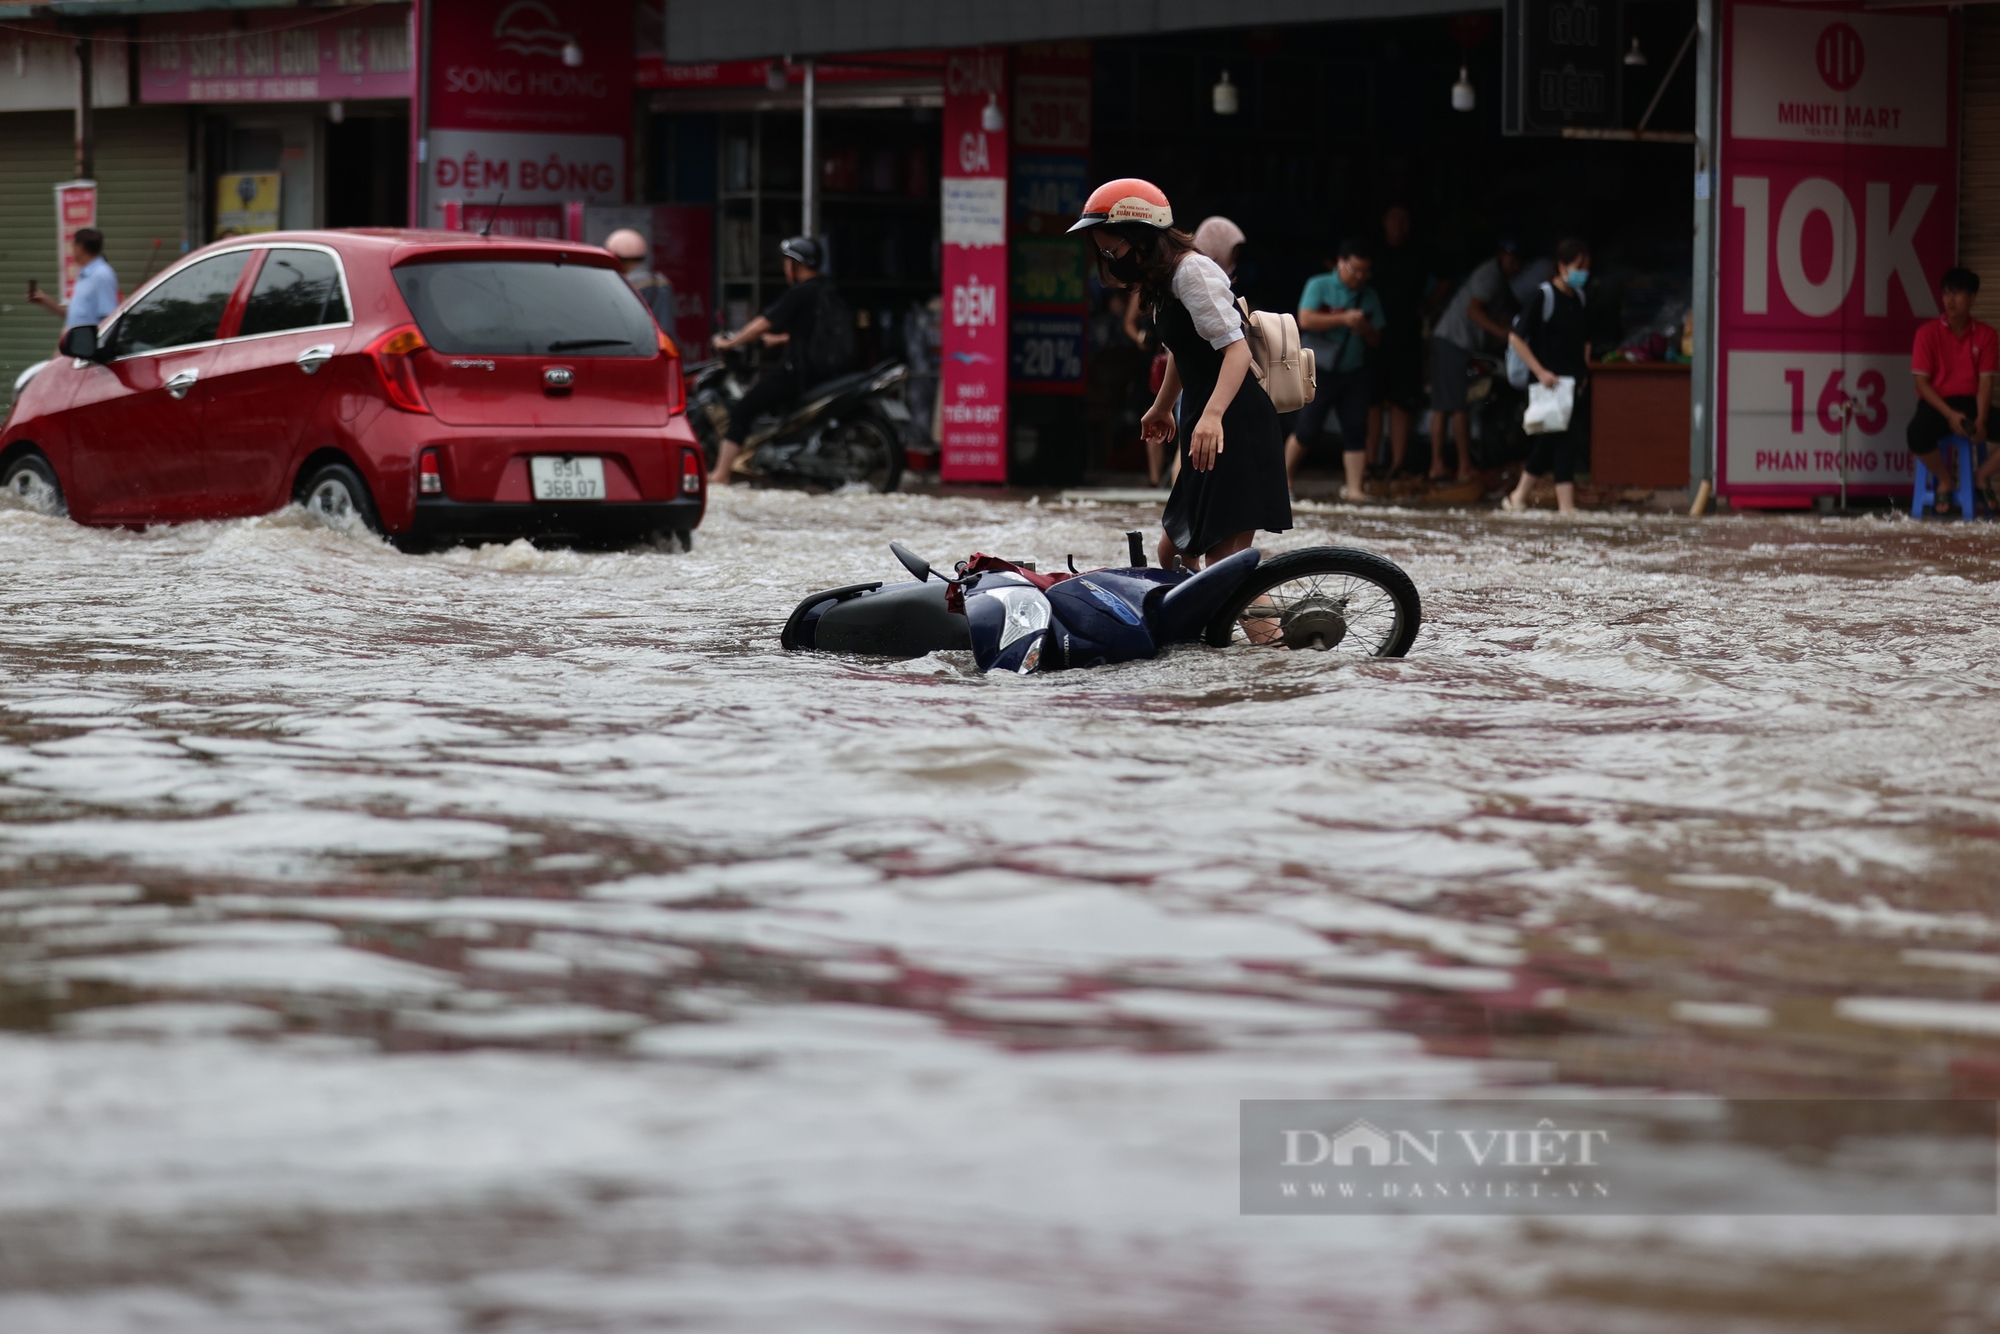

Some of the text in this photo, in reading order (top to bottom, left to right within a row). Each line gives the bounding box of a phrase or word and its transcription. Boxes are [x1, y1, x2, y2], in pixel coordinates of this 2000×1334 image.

[1777, 101, 1901, 130] MINITI MART
[436, 150, 616, 198] ĐỆM BÔNG
[1732, 175, 1942, 319] 10K
[951, 273, 997, 339] ĐỆM
[1013, 337, 1082, 379] -20%
[1784, 368, 1889, 436] 163
[1756, 450, 1808, 472] PHAN
[542, 479, 597, 498] 368.07
